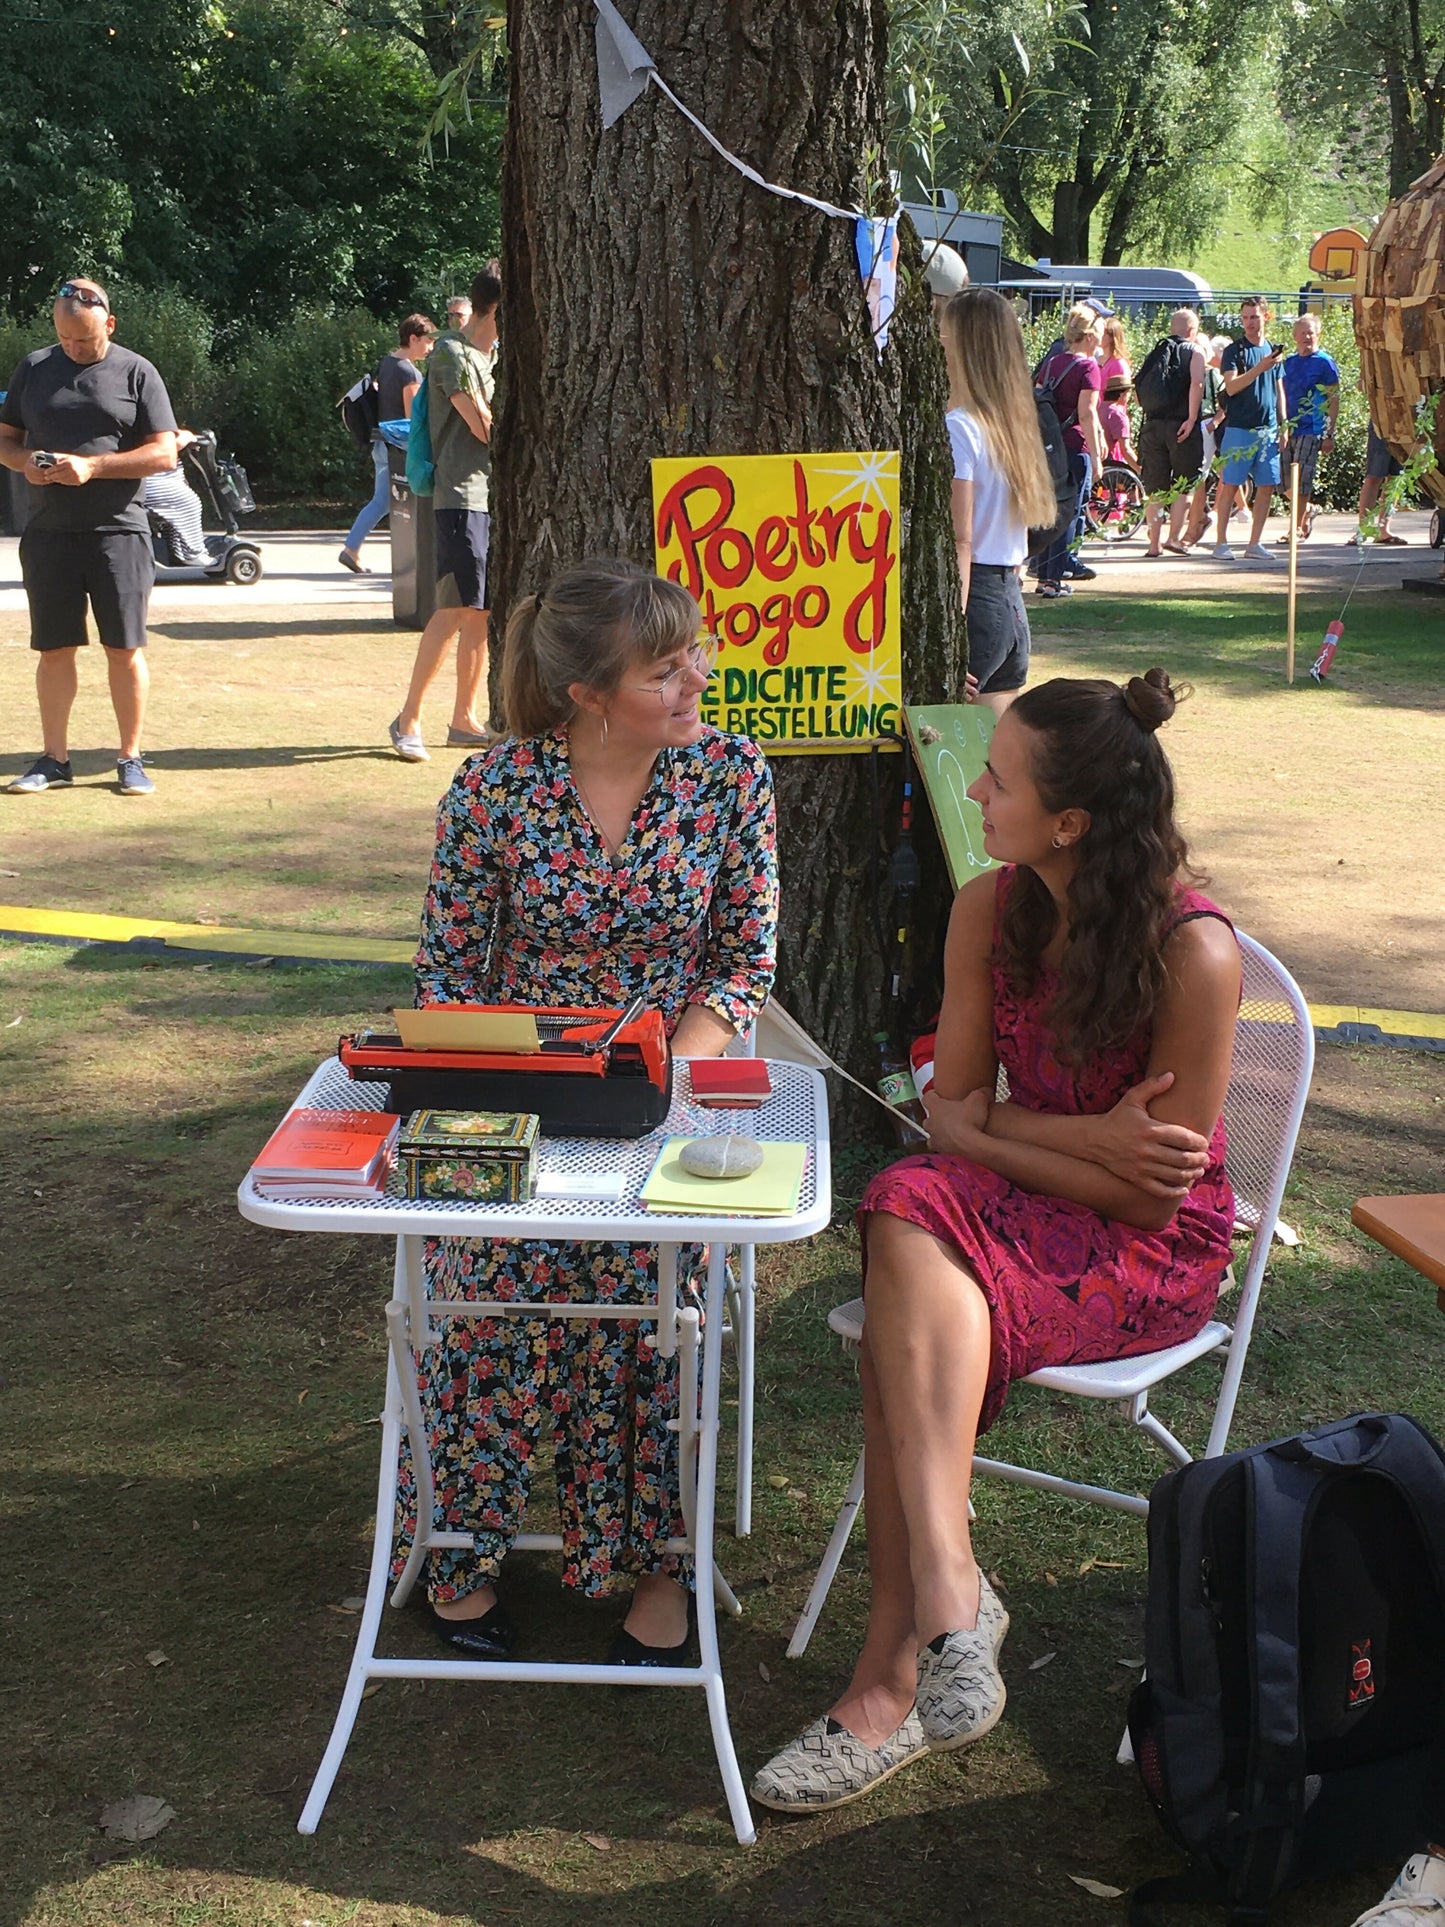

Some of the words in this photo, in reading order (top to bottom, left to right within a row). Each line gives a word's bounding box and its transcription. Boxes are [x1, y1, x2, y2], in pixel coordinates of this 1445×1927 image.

[657, 459, 896, 655] Poetry
[700, 666, 847, 706] EDICHTE
[727, 703, 899, 739] BESTELLUNG
